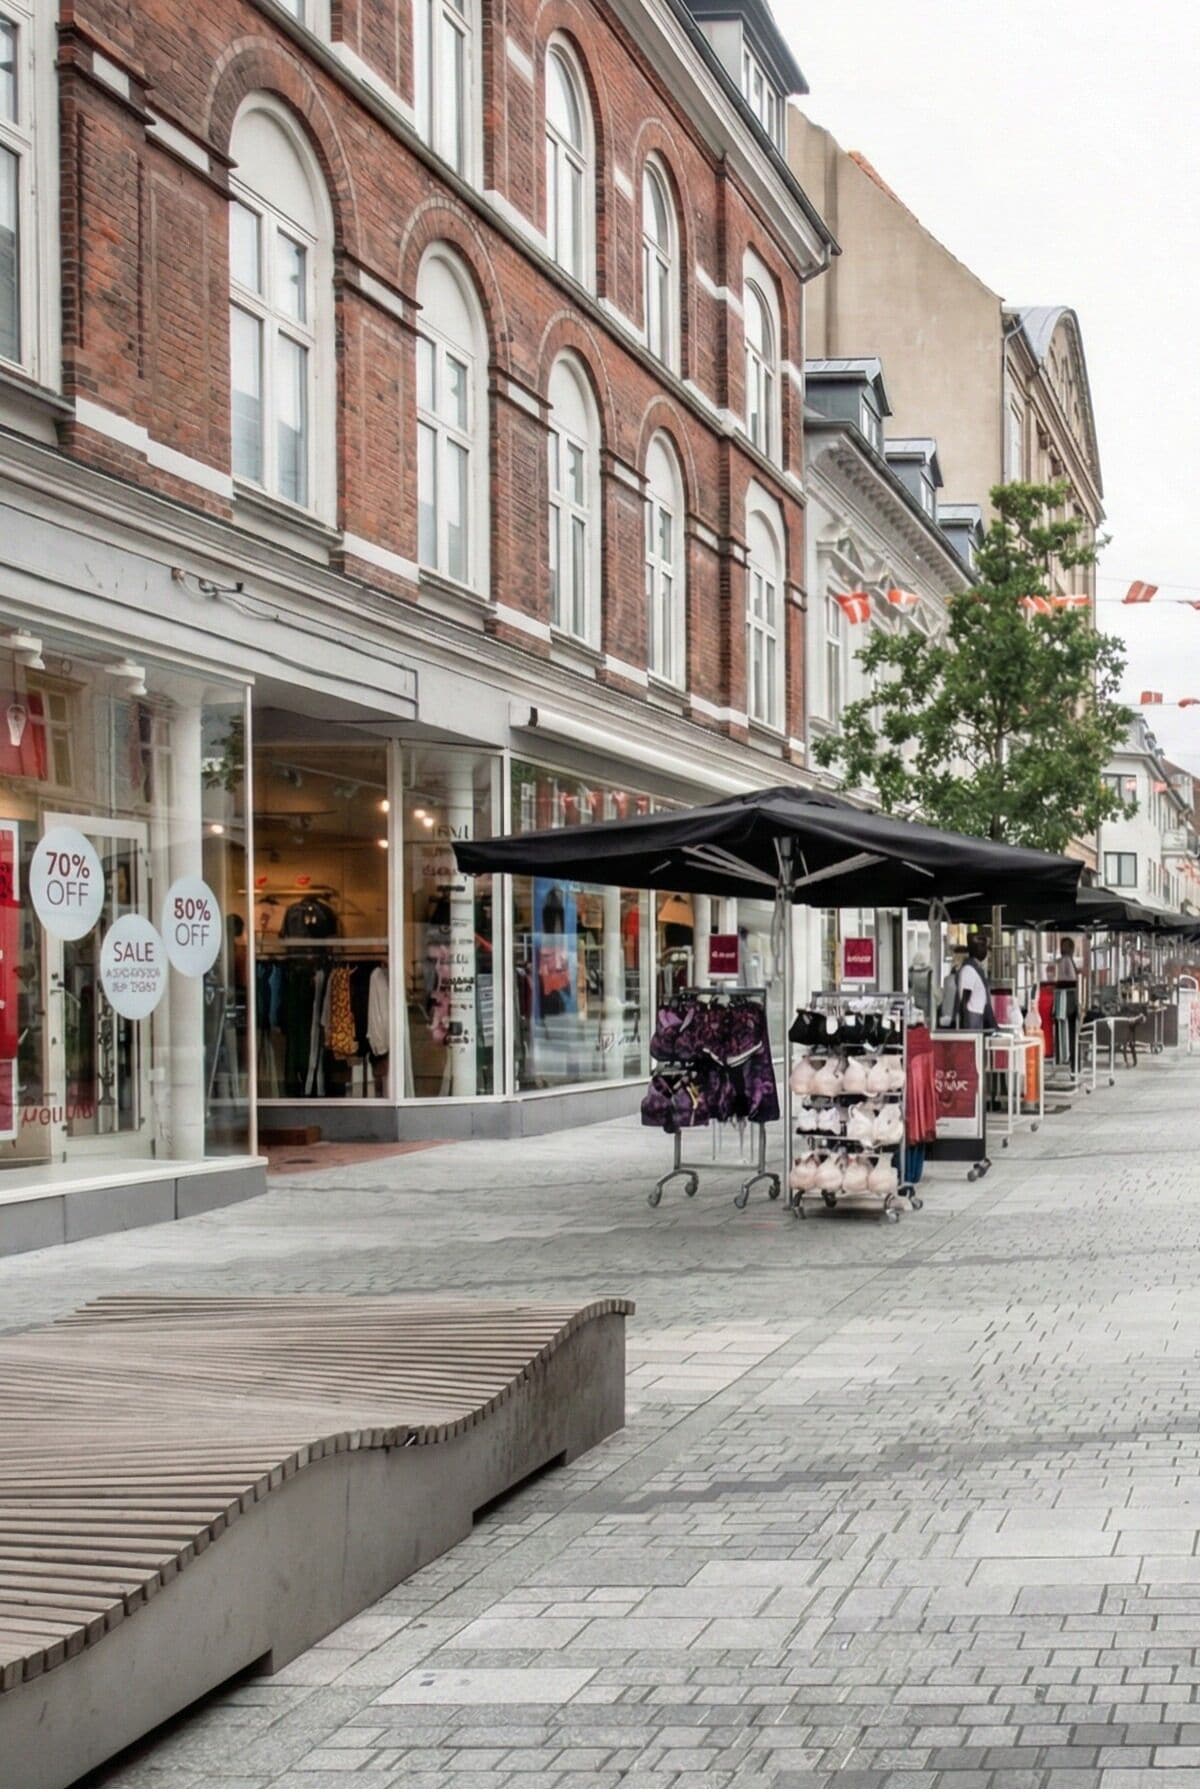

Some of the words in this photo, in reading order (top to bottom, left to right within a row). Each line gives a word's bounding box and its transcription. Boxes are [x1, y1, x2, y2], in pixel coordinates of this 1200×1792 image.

[45, 851, 90, 879] 70%
[46, 879, 90, 907] OFF
[174, 922, 210, 947] OFF
[113, 941, 154, 963] SALE
